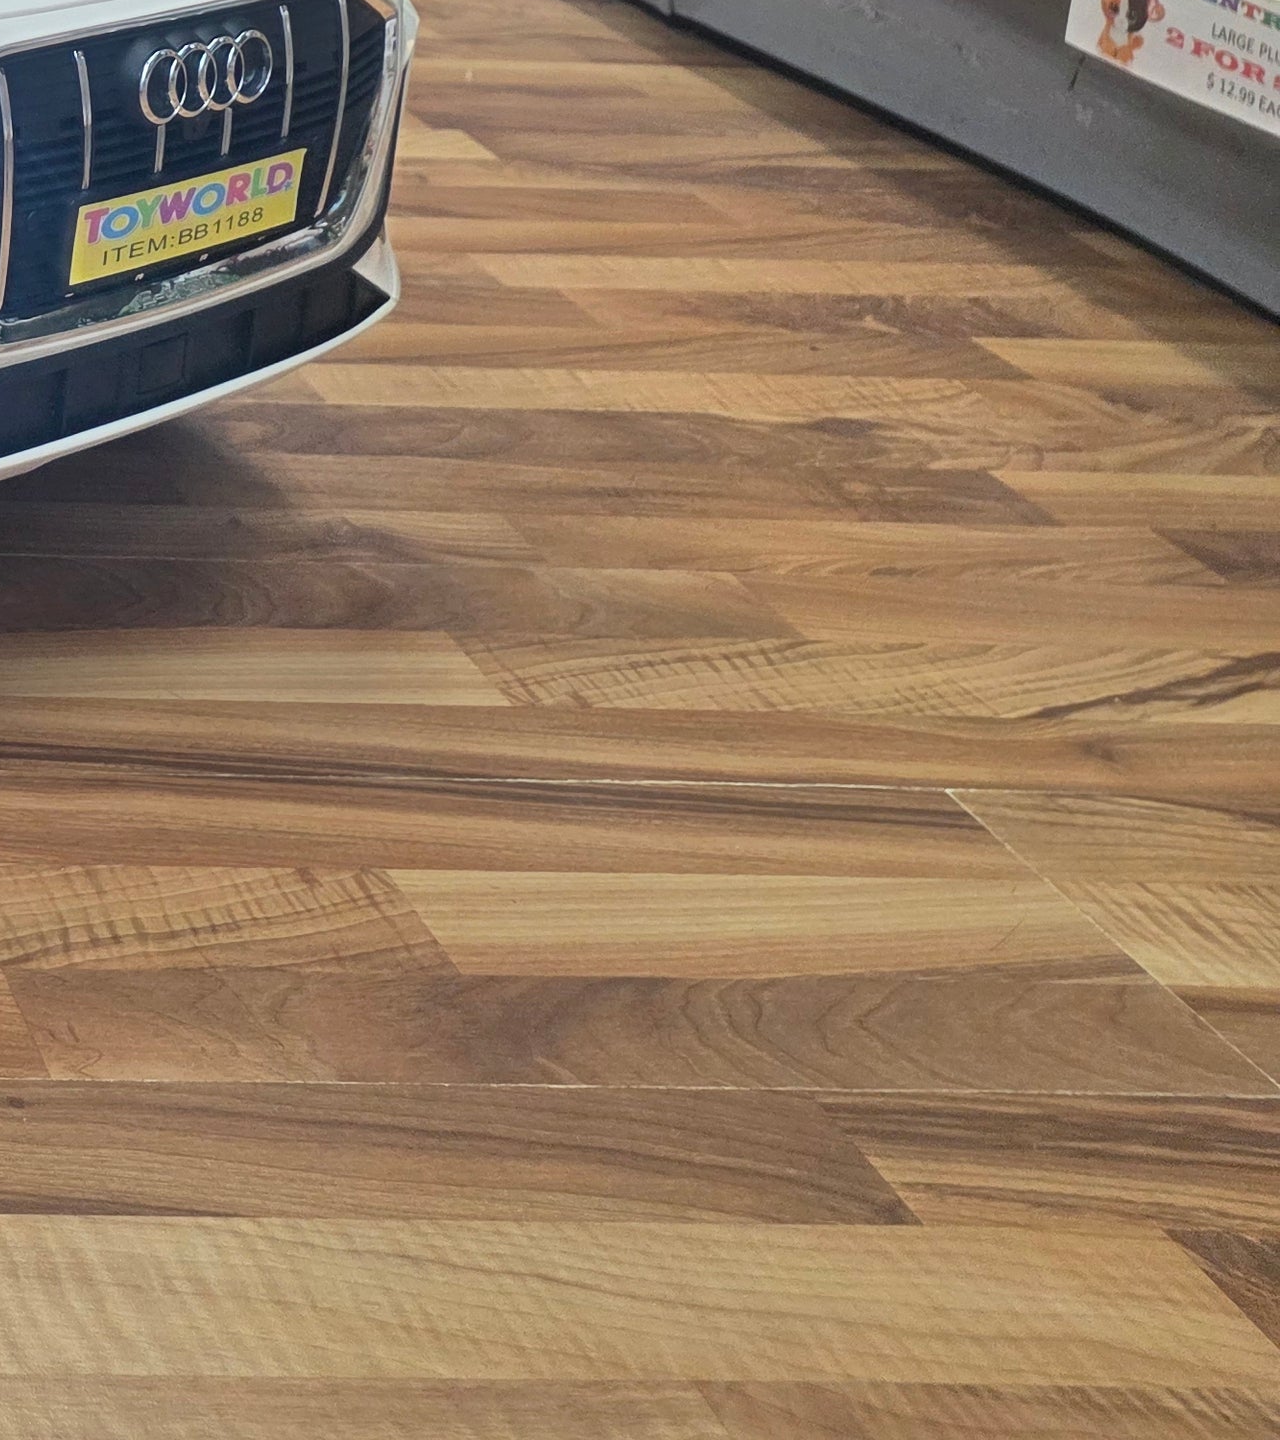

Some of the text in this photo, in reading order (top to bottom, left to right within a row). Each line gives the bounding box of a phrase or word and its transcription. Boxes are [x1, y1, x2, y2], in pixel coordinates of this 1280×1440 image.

[1165, 26, 1185, 50] 2
[1190, 36, 1266, 85] FOR
[1211, 21, 1255, 56] LARGE
[1219, 77, 1256, 108] 12.99
[84, 161, 294, 245] TOYWORLD
[102, 207, 264, 266] ITEM:BB1188
